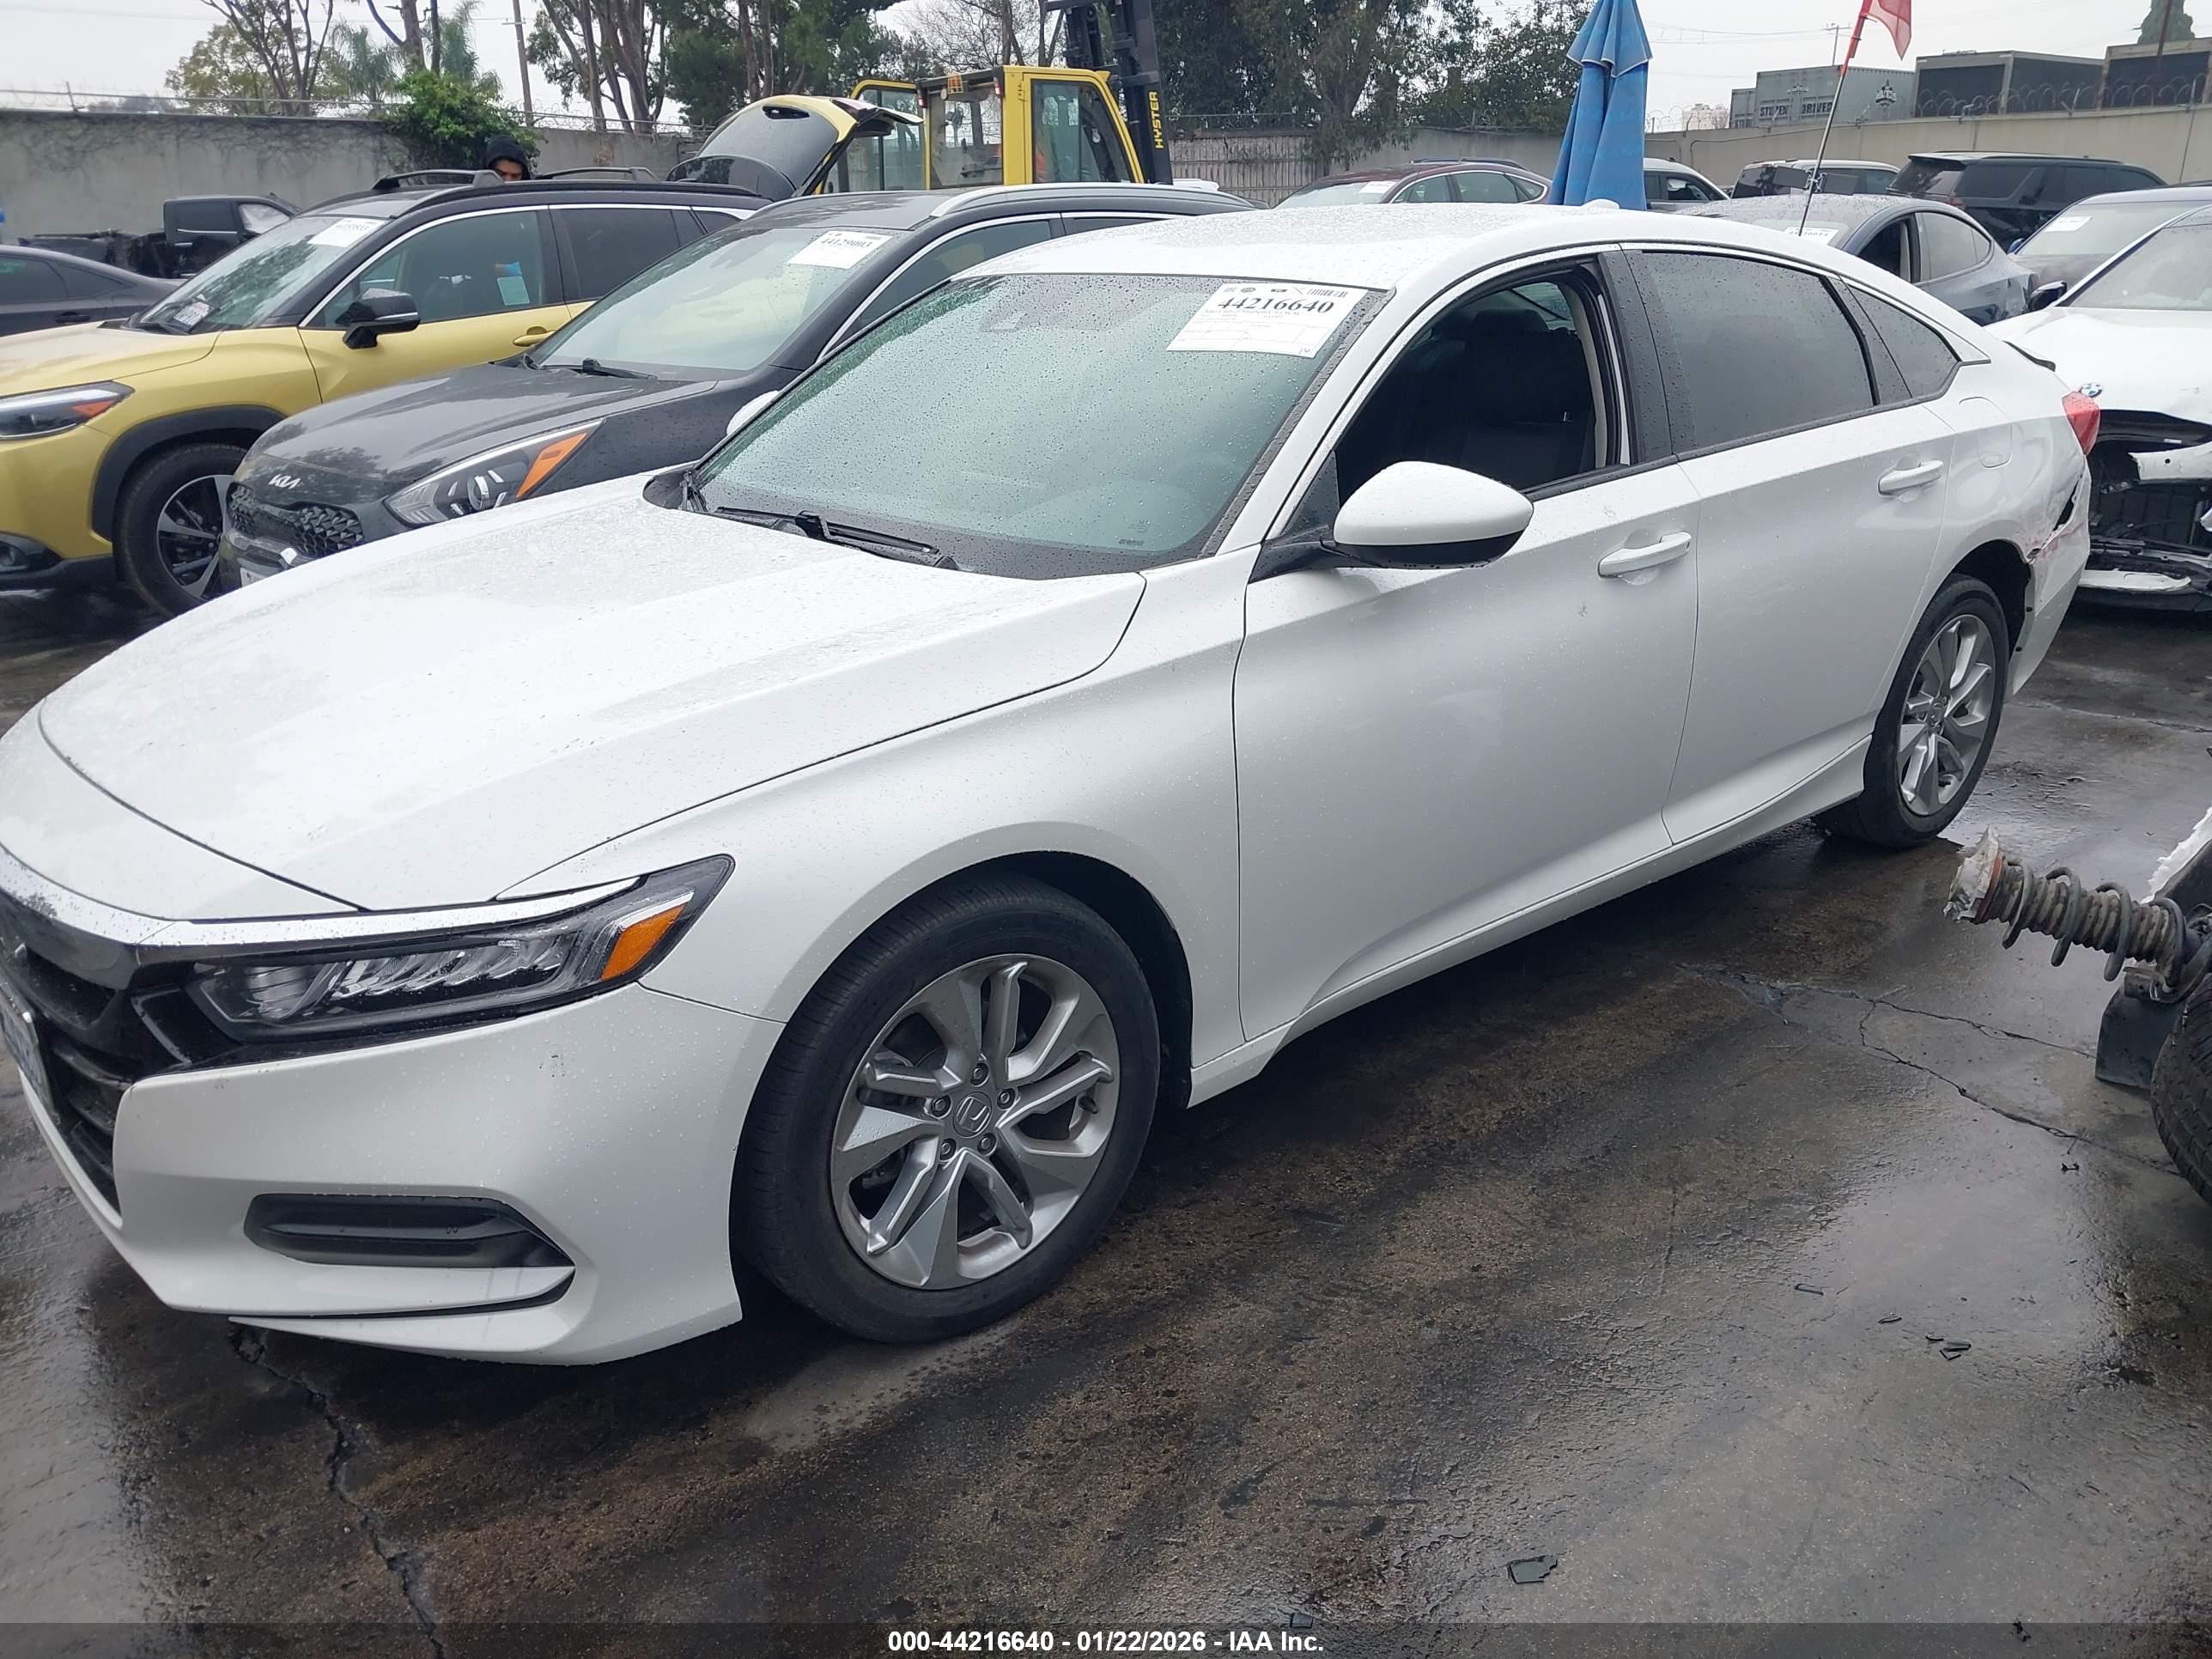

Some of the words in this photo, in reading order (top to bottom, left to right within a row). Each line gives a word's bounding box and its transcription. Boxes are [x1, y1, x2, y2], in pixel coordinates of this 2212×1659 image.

[1149, 91, 1164, 149] HYSTER
[1218, 296, 1334, 314] 44216640
[268, 473, 301, 489] KIA
